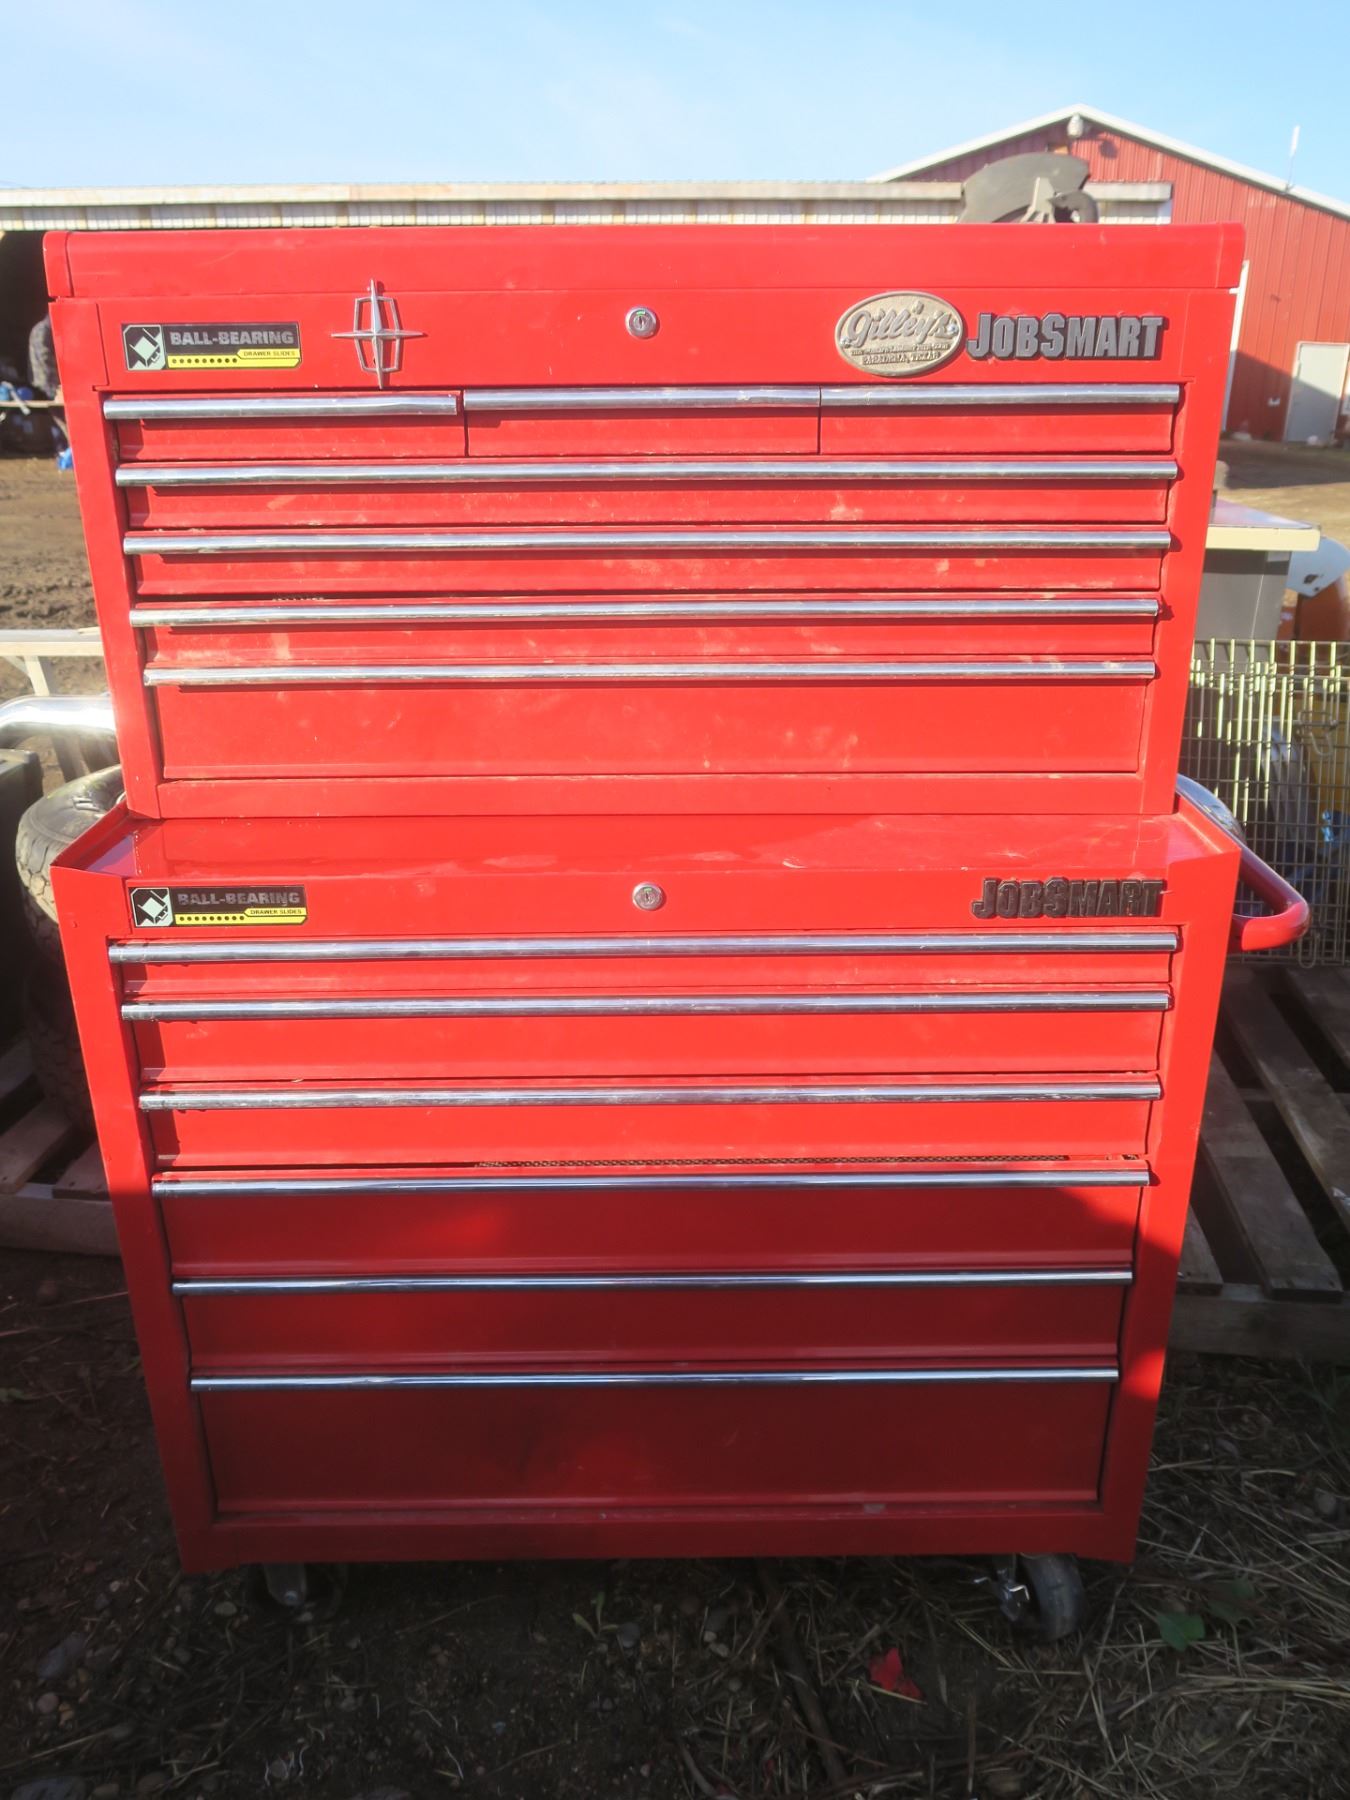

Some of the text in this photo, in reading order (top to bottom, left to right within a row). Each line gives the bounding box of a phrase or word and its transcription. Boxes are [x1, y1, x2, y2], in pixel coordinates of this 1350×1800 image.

[843, 300, 958, 349] Gilley's
[169, 330, 295, 346] BALL-BEARING
[177, 892, 300, 907] BALL-BEARING
